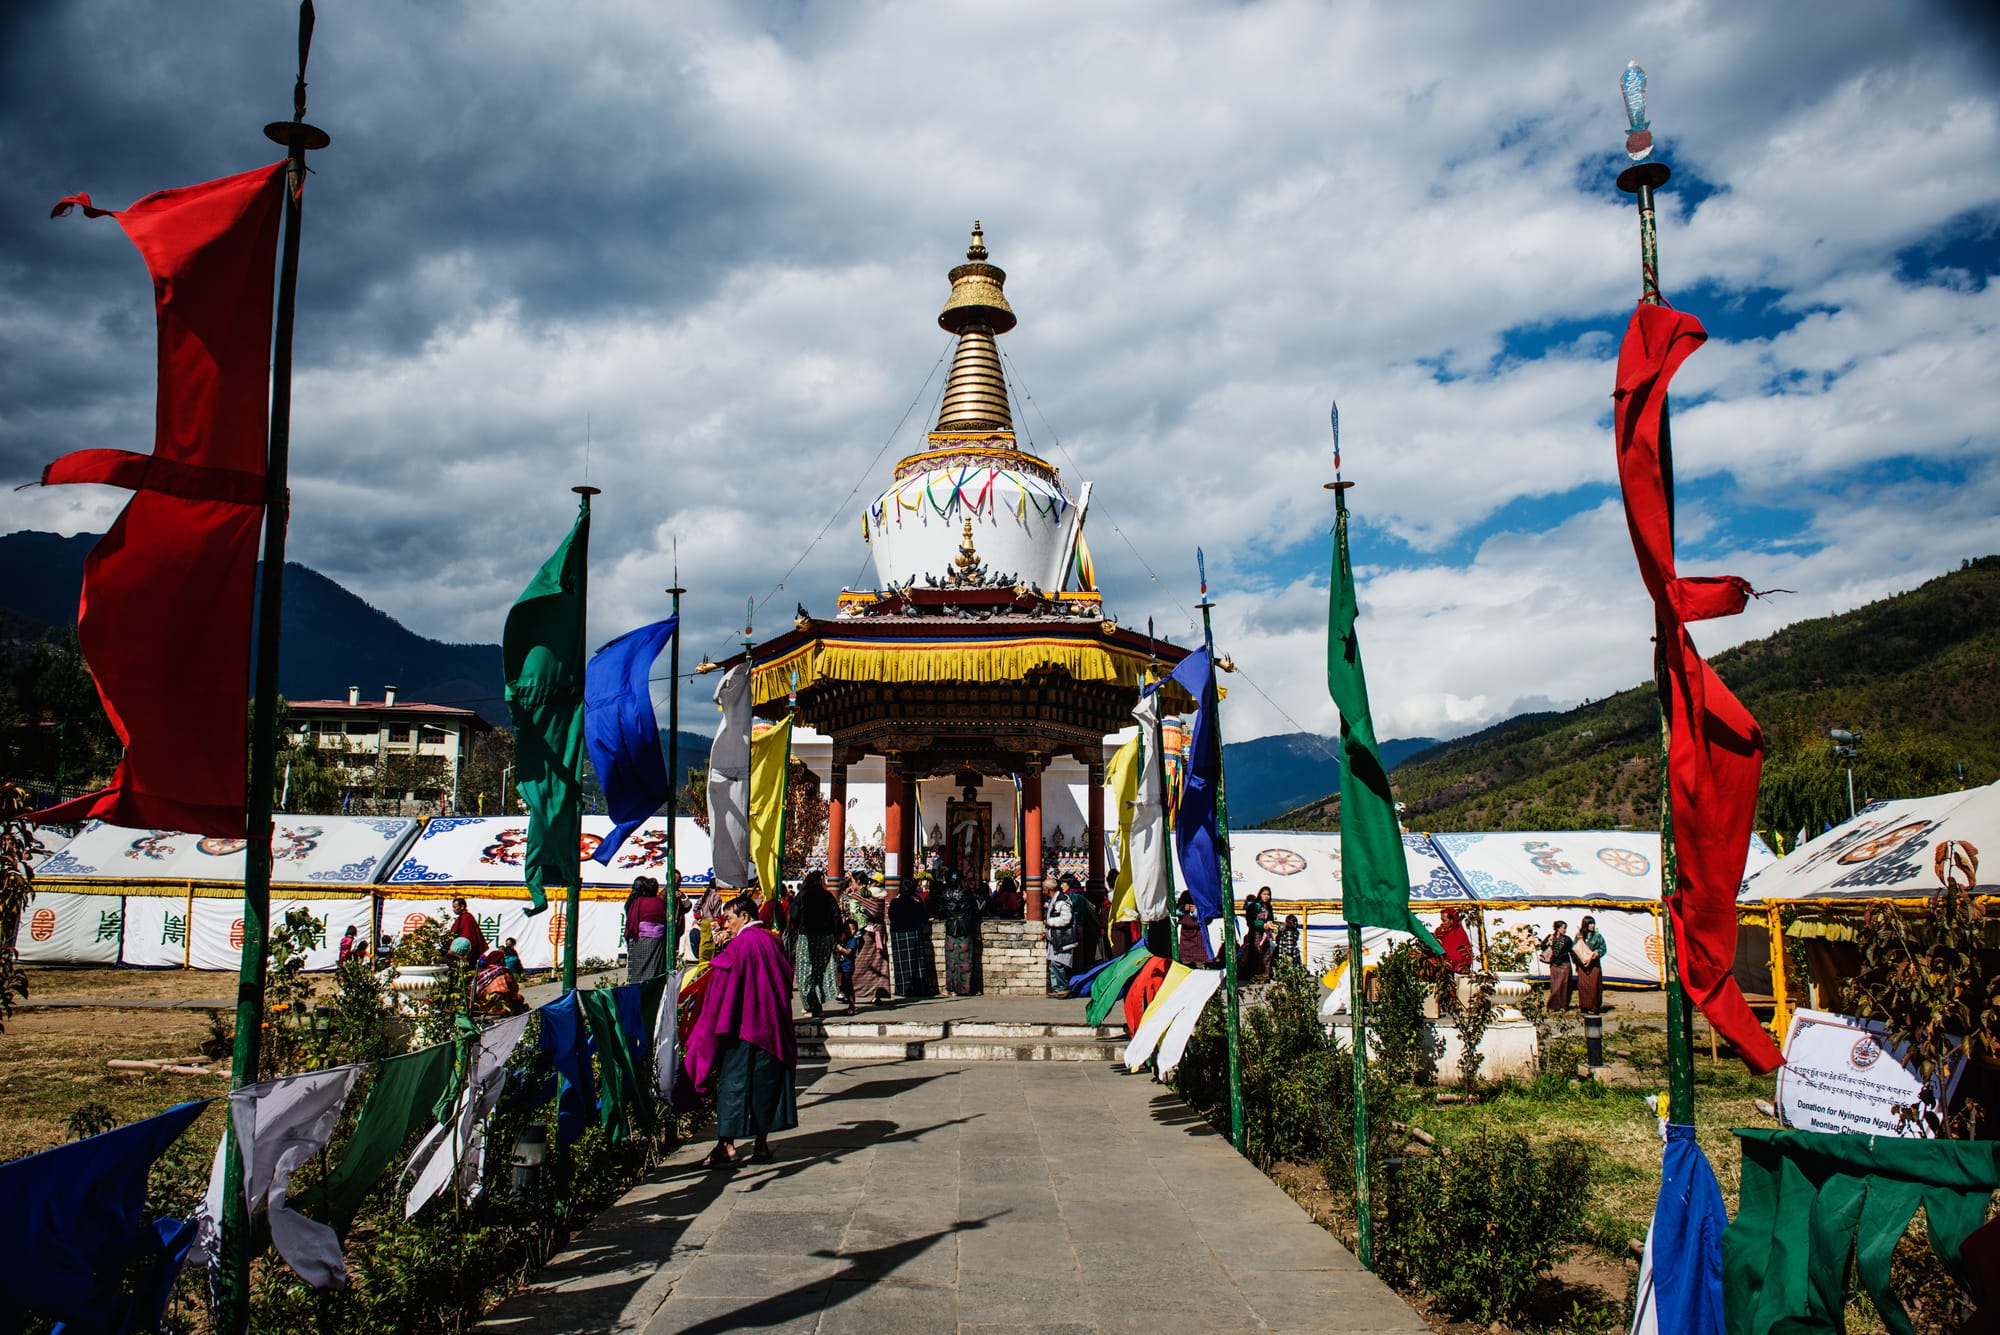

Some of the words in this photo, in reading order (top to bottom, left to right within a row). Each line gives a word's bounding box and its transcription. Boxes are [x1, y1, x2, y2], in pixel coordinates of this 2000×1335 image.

[1797, 1099, 1826, 1114] Donation
[1826, 1106, 1837, 1116] for
[1838, 1109, 1871, 1125] Nyingma
[1872, 1117, 1898, 1132] Ngaju
